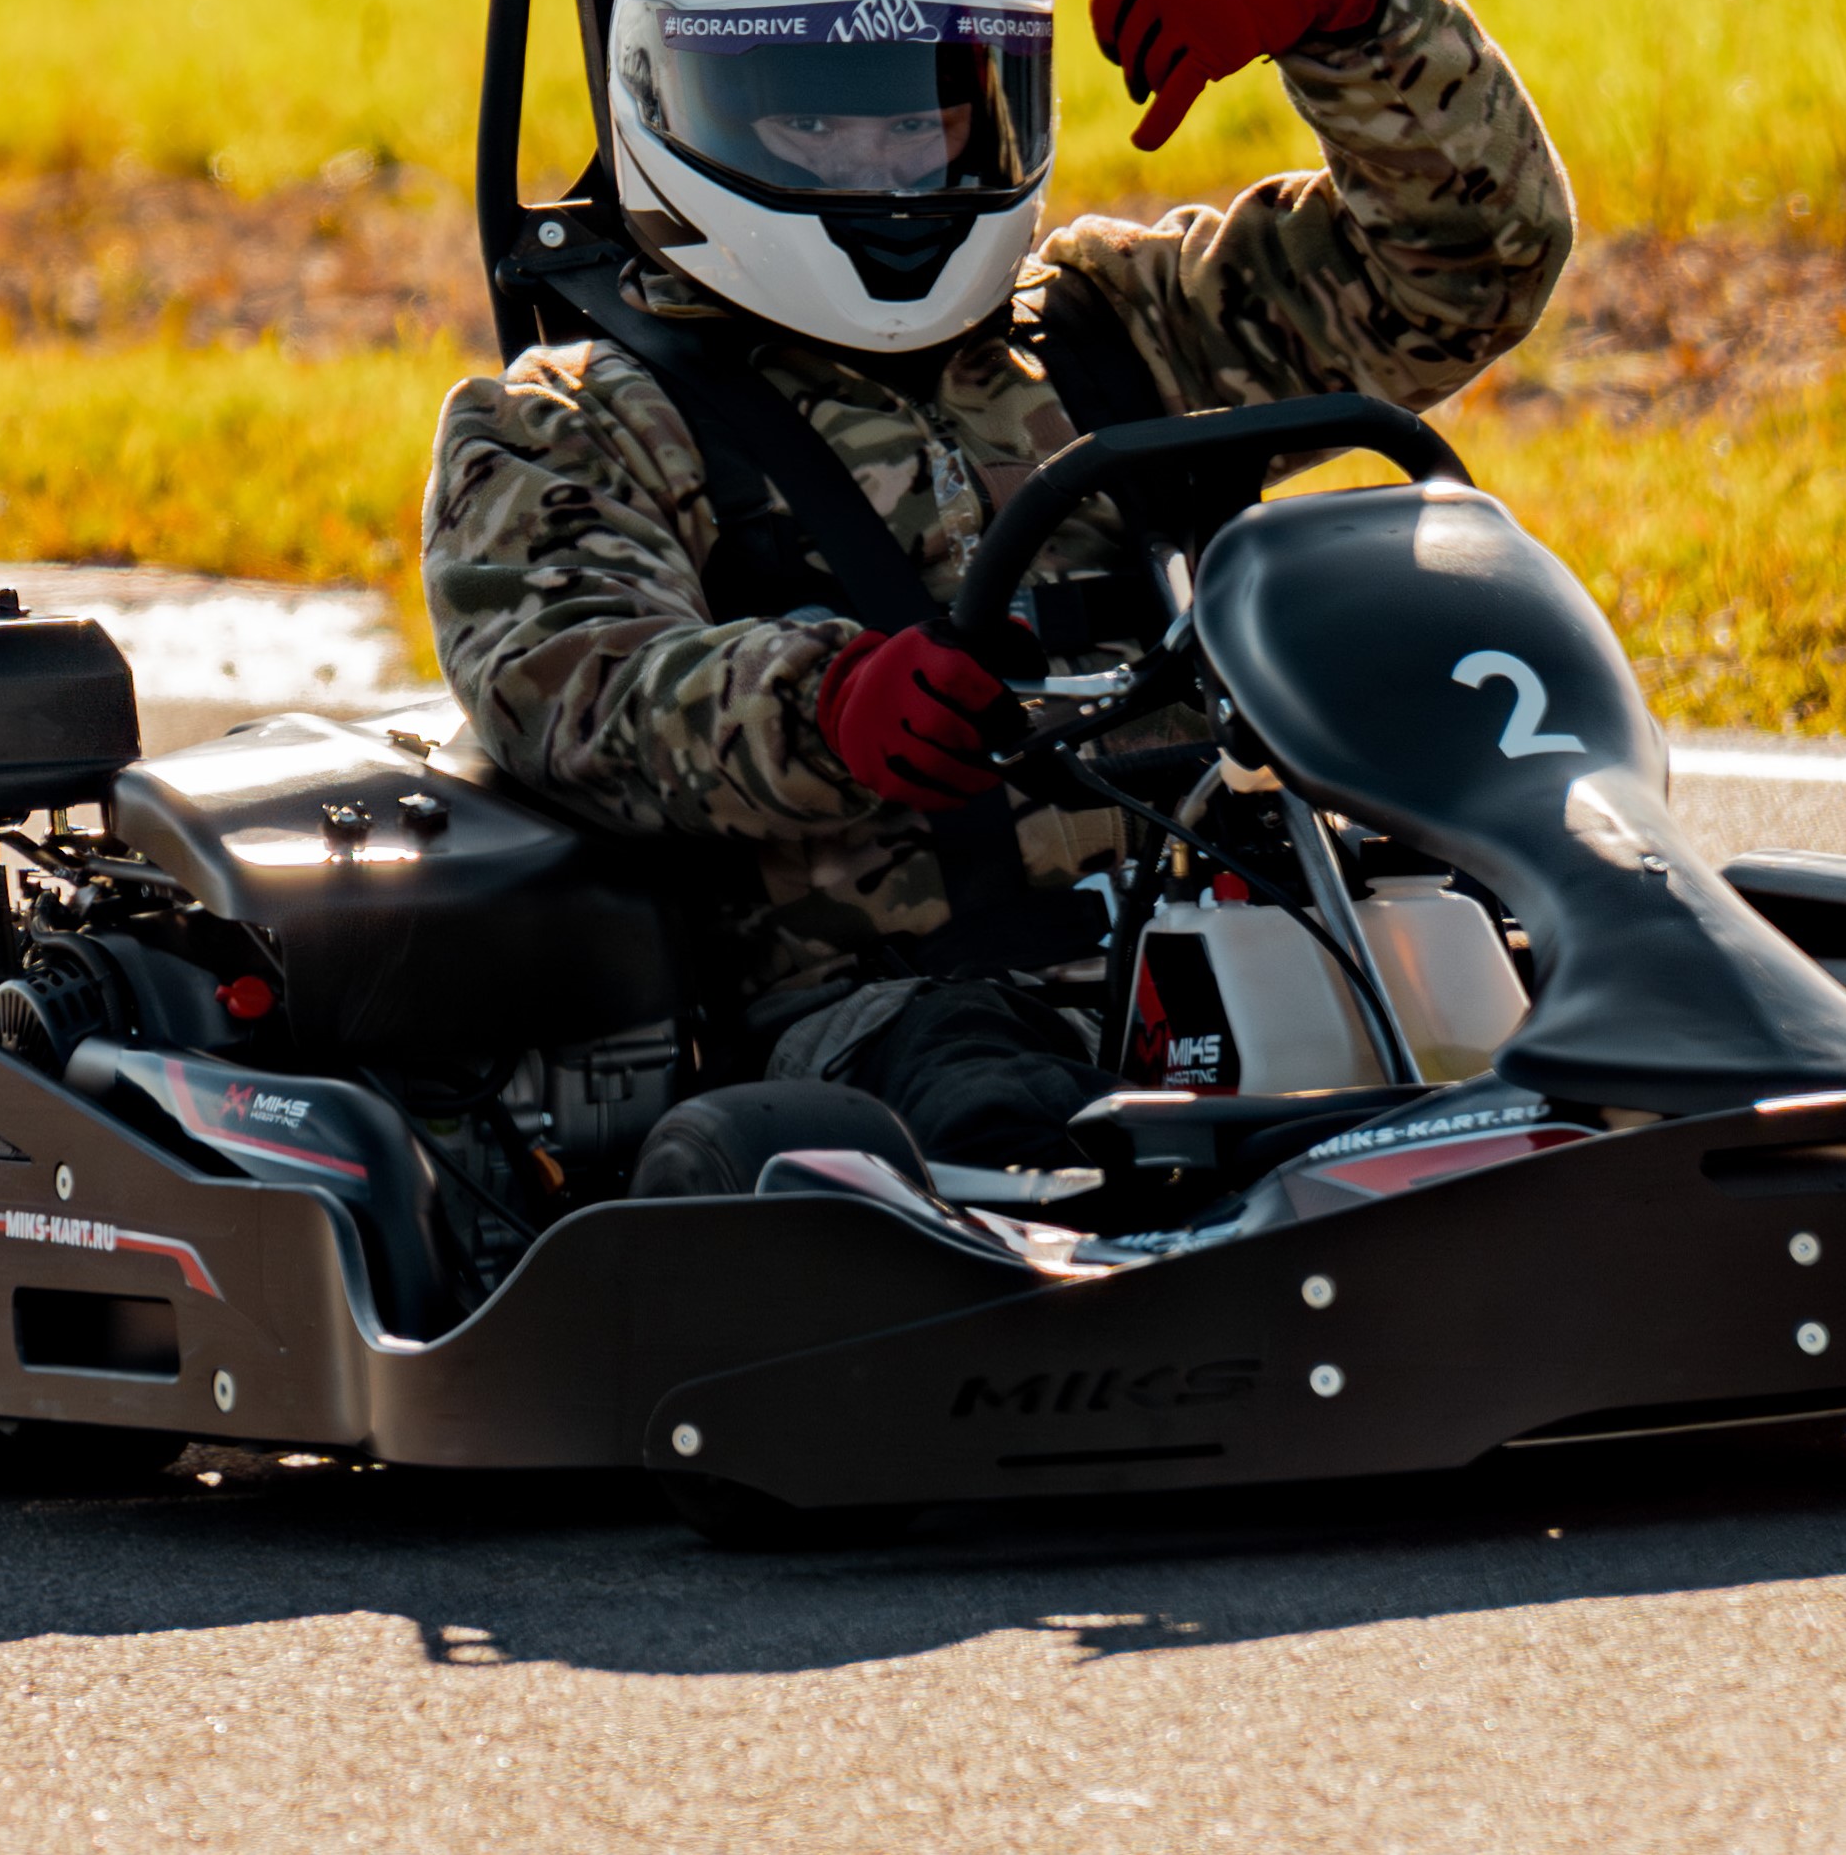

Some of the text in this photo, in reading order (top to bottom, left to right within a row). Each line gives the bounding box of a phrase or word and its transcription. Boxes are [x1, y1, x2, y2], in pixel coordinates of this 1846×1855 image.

[664, 16, 808, 36] #IGORADRIVE
[1451, 650, 1587, 760] 2
[1167, 1033, 1222, 1068] MIKS
[252, 1092, 312, 1119] MIKS
[1308, 1103, 1552, 1161] MIKS-KART.RU
[5, 1209, 116, 1252] MIKS-KART.RU
[949, 1357, 1264, 1418] MIKS
